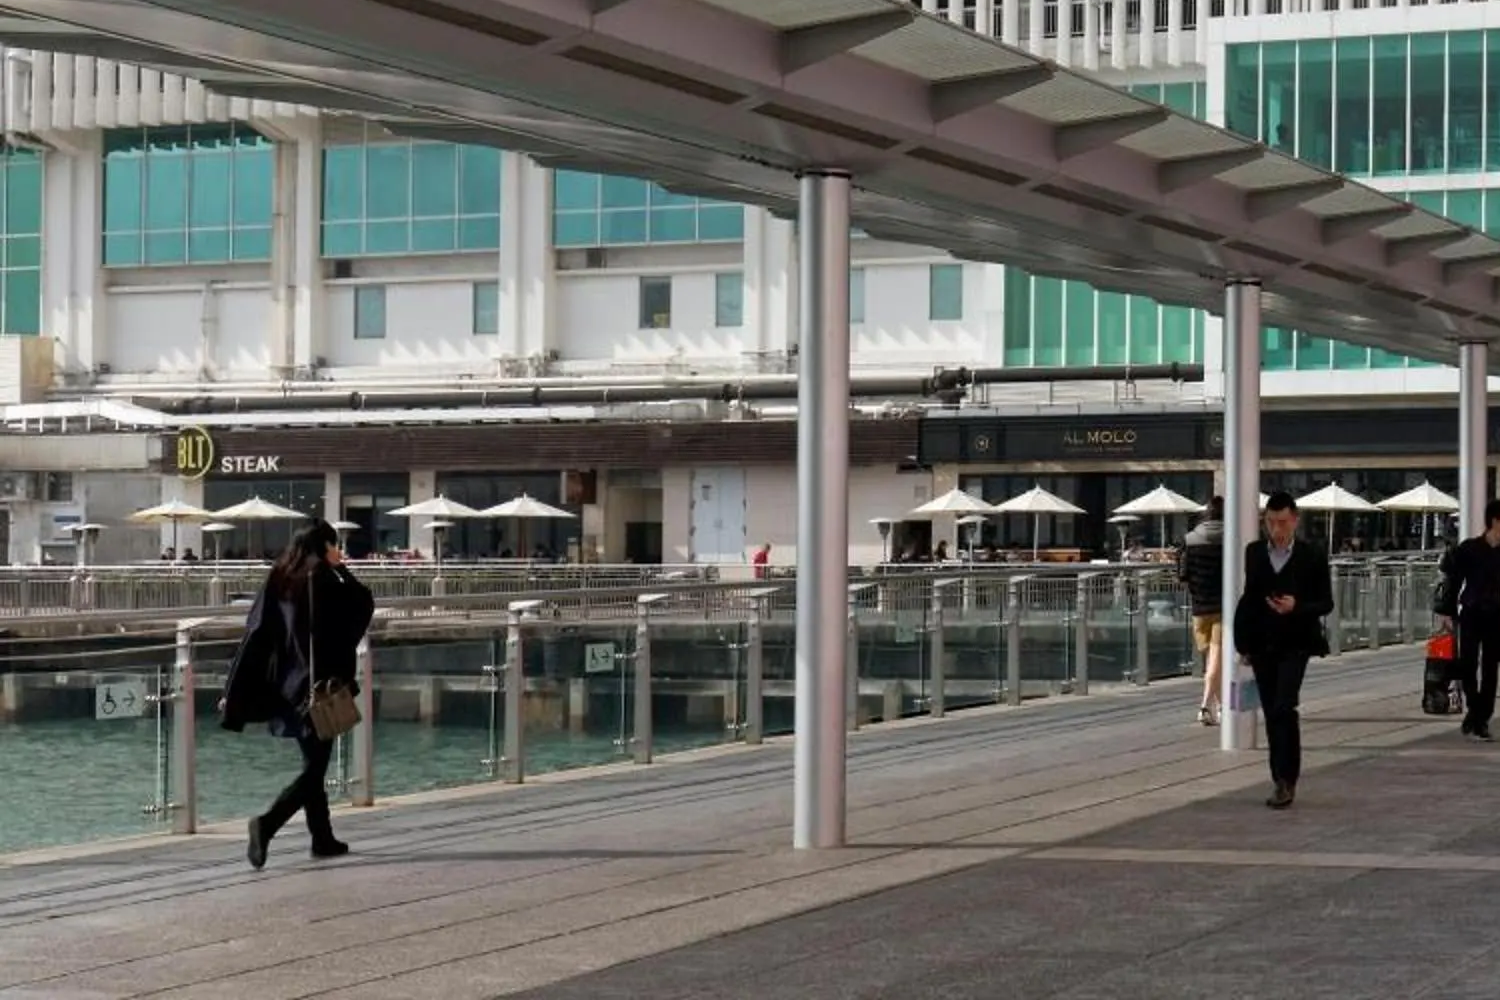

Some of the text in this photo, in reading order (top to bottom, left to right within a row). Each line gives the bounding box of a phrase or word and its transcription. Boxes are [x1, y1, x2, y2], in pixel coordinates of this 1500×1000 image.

[1063, 428, 1138, 445] AL MOLO
[177, 435, 280, 473] BLT STEAK
